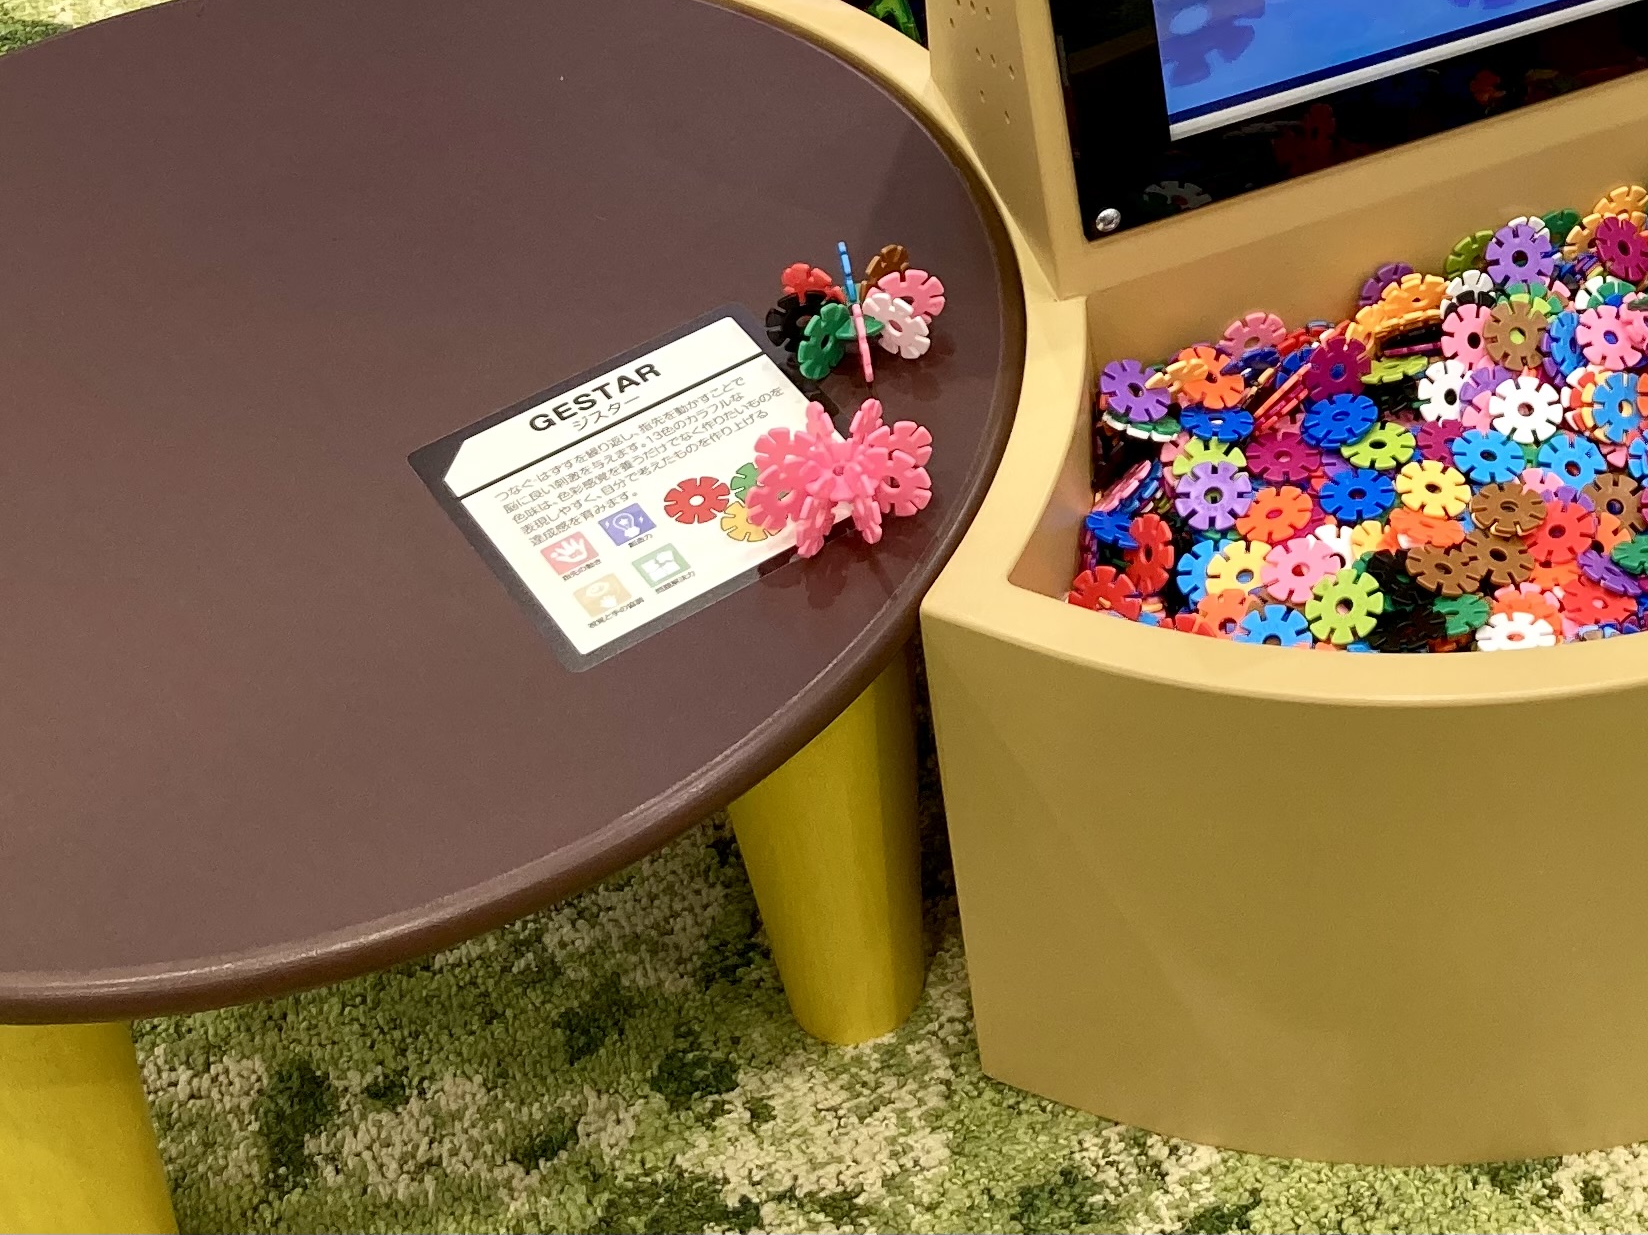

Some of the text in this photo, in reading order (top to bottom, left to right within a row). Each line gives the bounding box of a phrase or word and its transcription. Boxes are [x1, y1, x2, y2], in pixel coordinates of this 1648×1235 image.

[529, 364, 661, 431] GESTAR
[573, 396, 640, 431] ジスター
